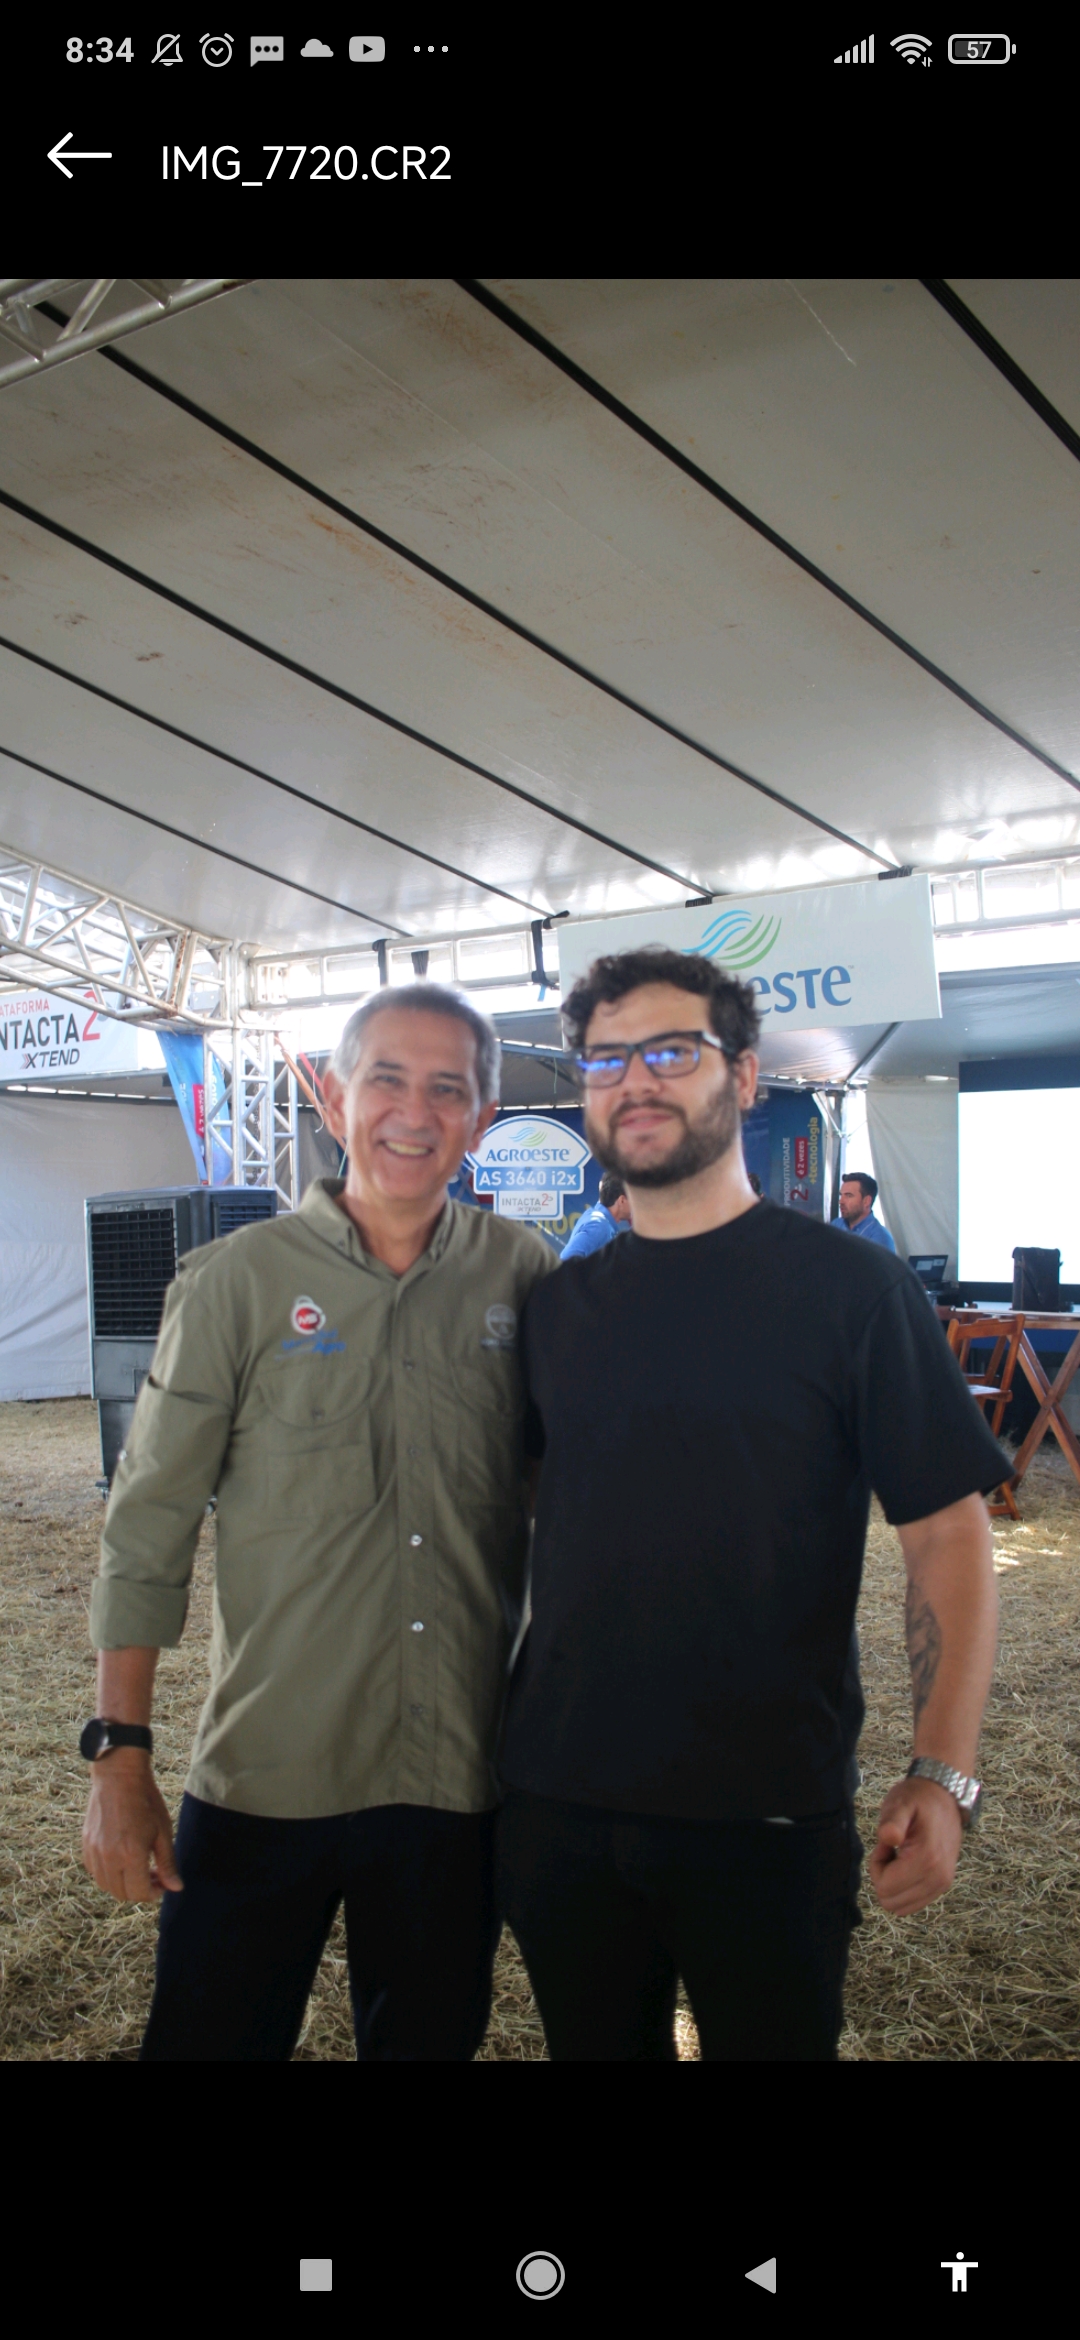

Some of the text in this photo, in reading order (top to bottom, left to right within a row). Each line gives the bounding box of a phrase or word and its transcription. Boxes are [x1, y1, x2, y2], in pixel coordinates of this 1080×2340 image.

[24, 1048, 80, 1069] XTEND
[479, 1170, 577, 1186] AS 3640 i2x
[501, 1197, 541, 1206] INTACTA
